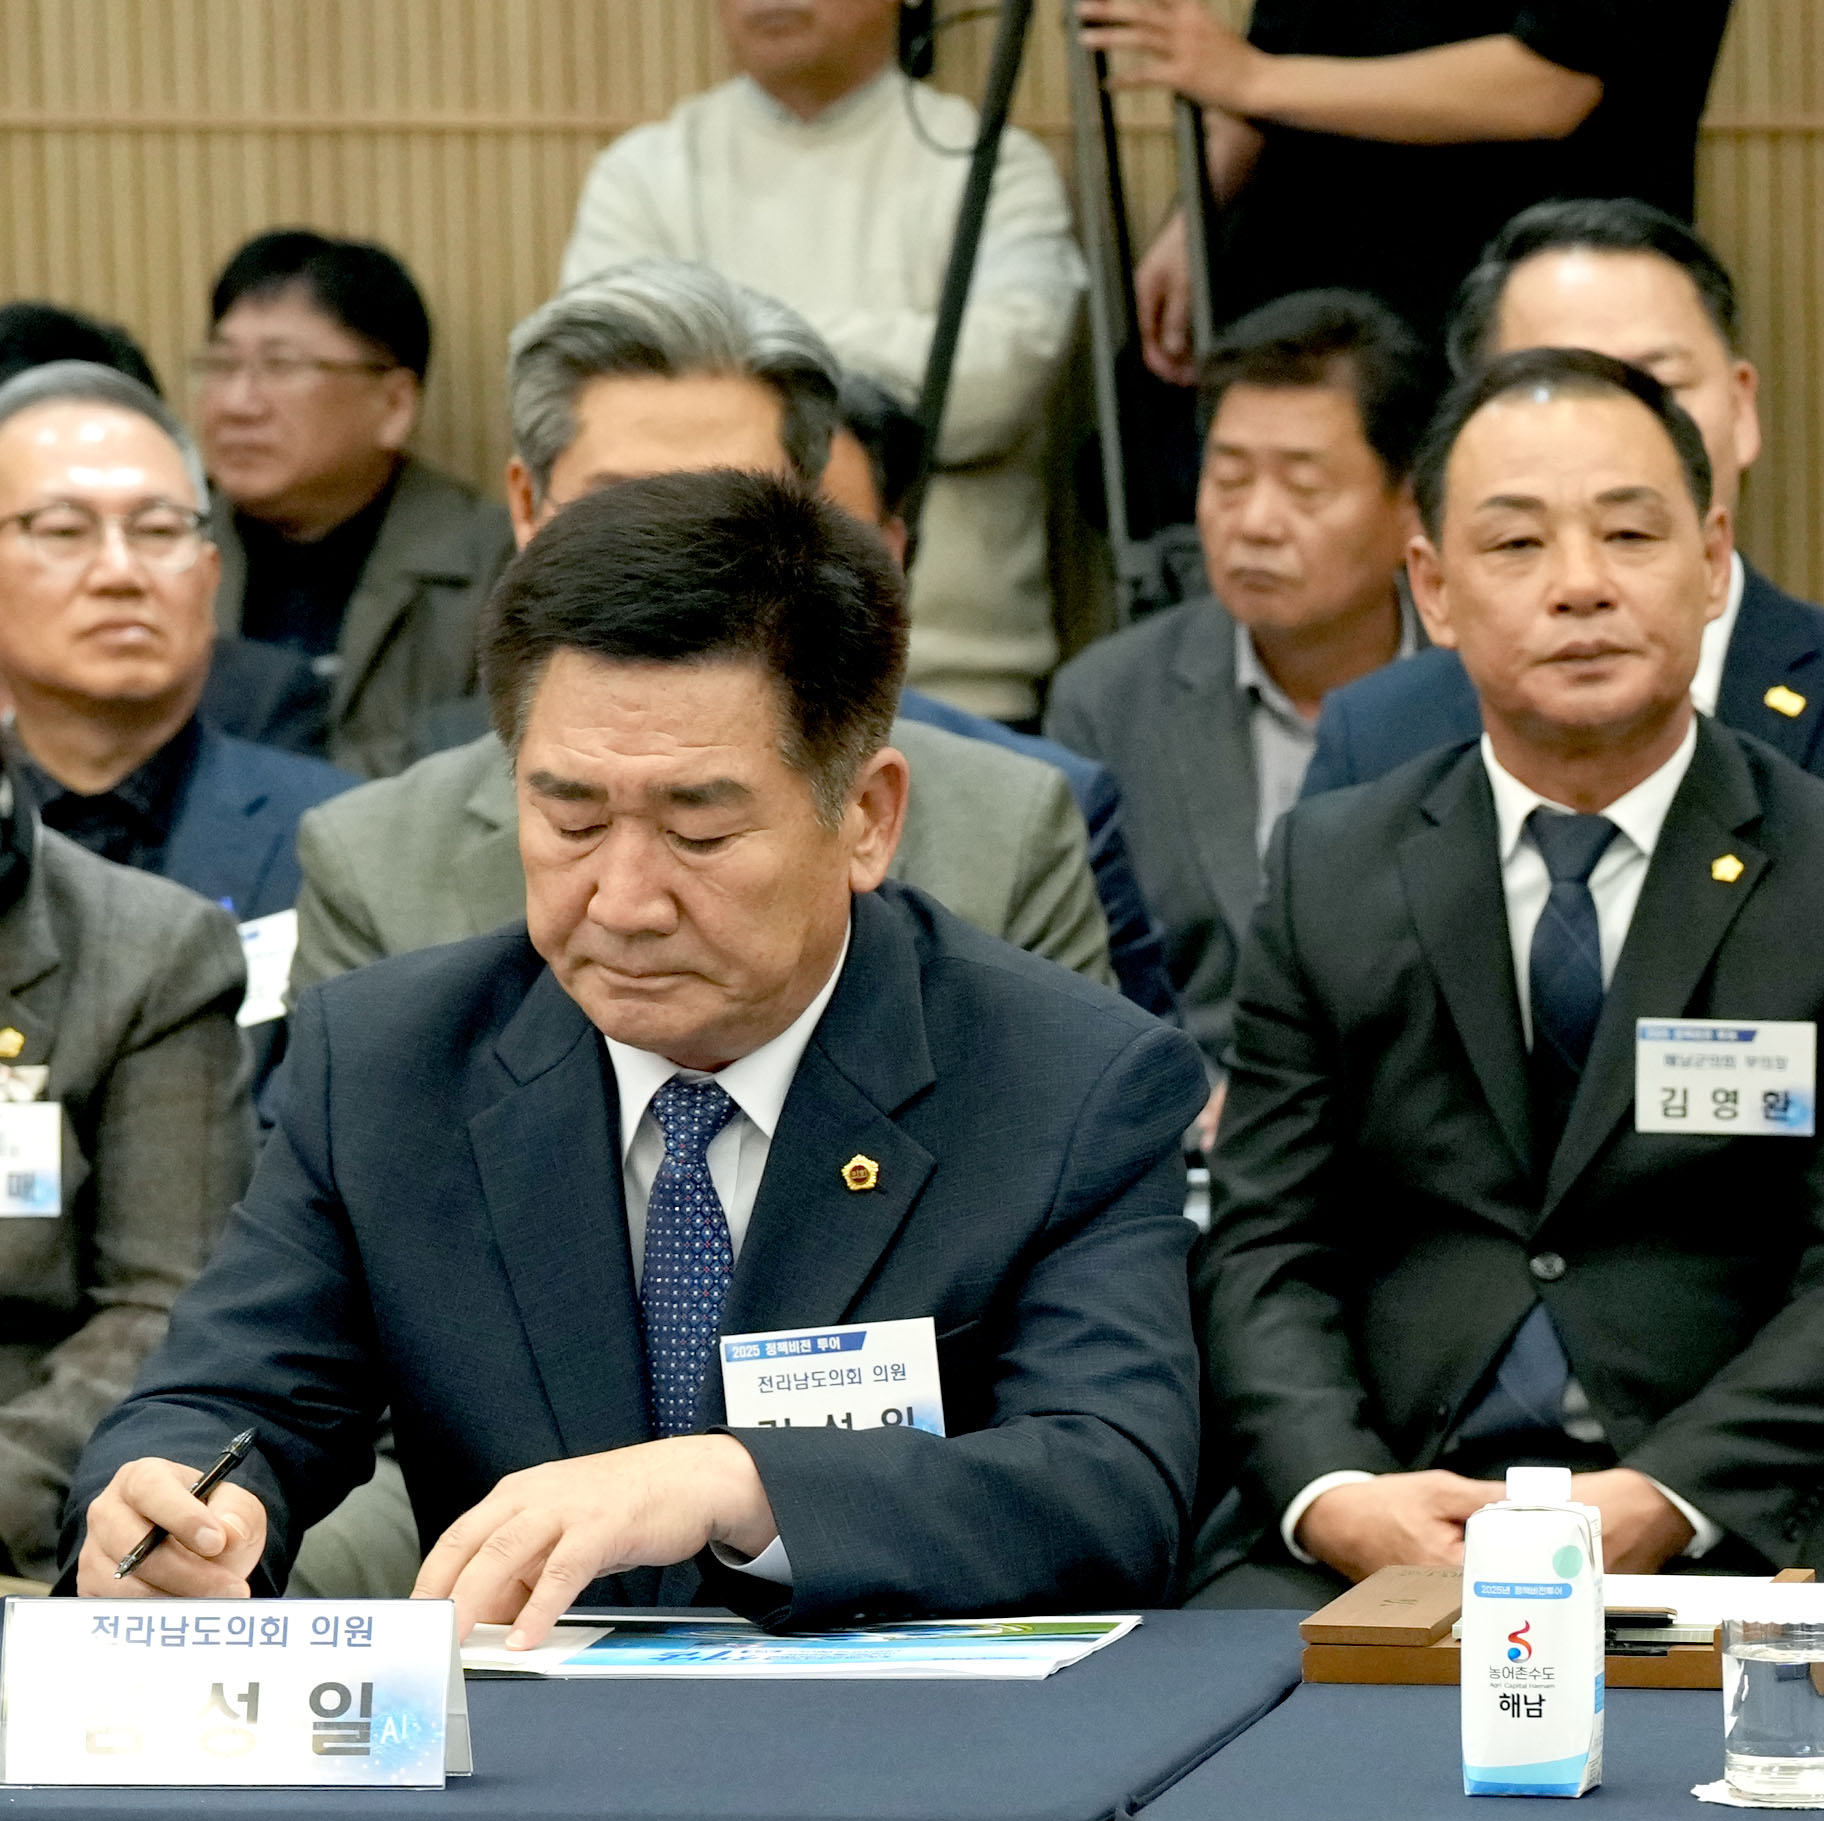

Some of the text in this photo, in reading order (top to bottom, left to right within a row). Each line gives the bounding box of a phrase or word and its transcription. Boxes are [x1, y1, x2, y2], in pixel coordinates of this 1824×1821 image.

[731, 1336, 841, 1360] 2025 정책비전 투어
[758, 1362, 908, 1394] 전라남도의회 의원
[91, 1615, 375, 1648] 전라남도의회 의원
[1488, 1665, 1556, 1681] 농어촌수도
[1499, 1692, 1546, 1718] 해남
[380, 1714, 408, 1745] AI
